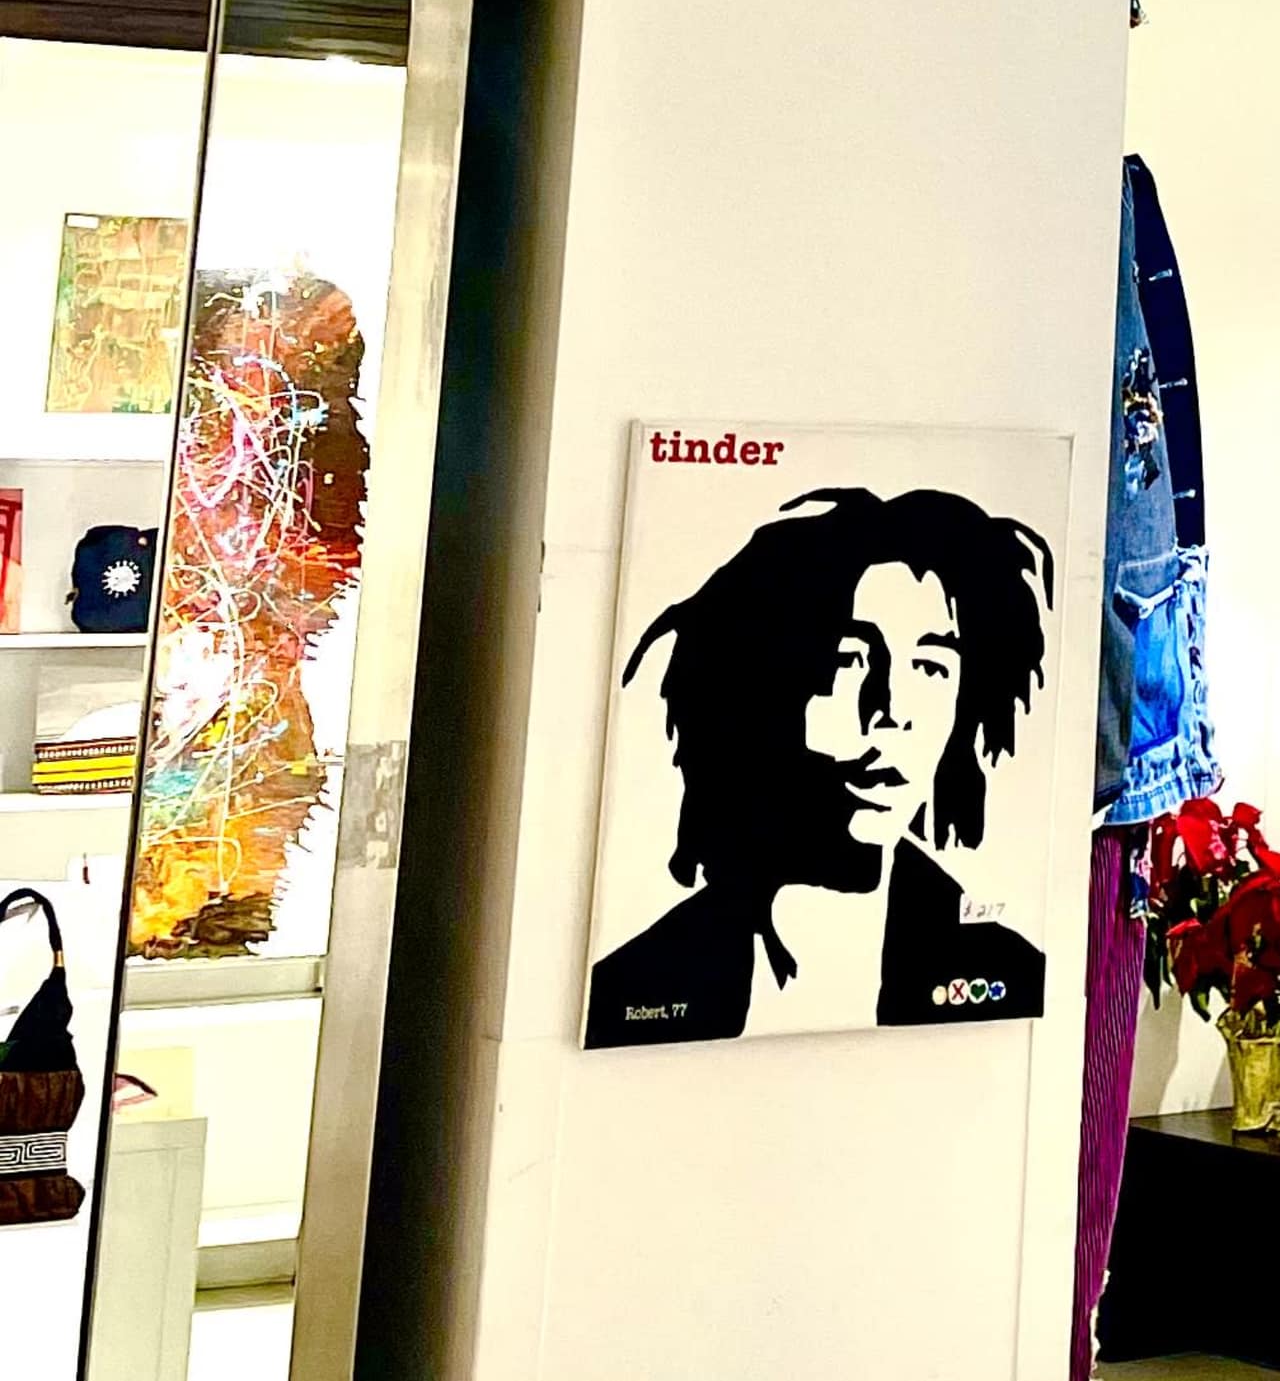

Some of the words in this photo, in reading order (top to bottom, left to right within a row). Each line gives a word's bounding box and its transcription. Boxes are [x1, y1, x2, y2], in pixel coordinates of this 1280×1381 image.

[649, 430, 785, 465] tinder
[624, 1004, 670, 1021] Robert,
[672, 1002, 689, 1018] 77
